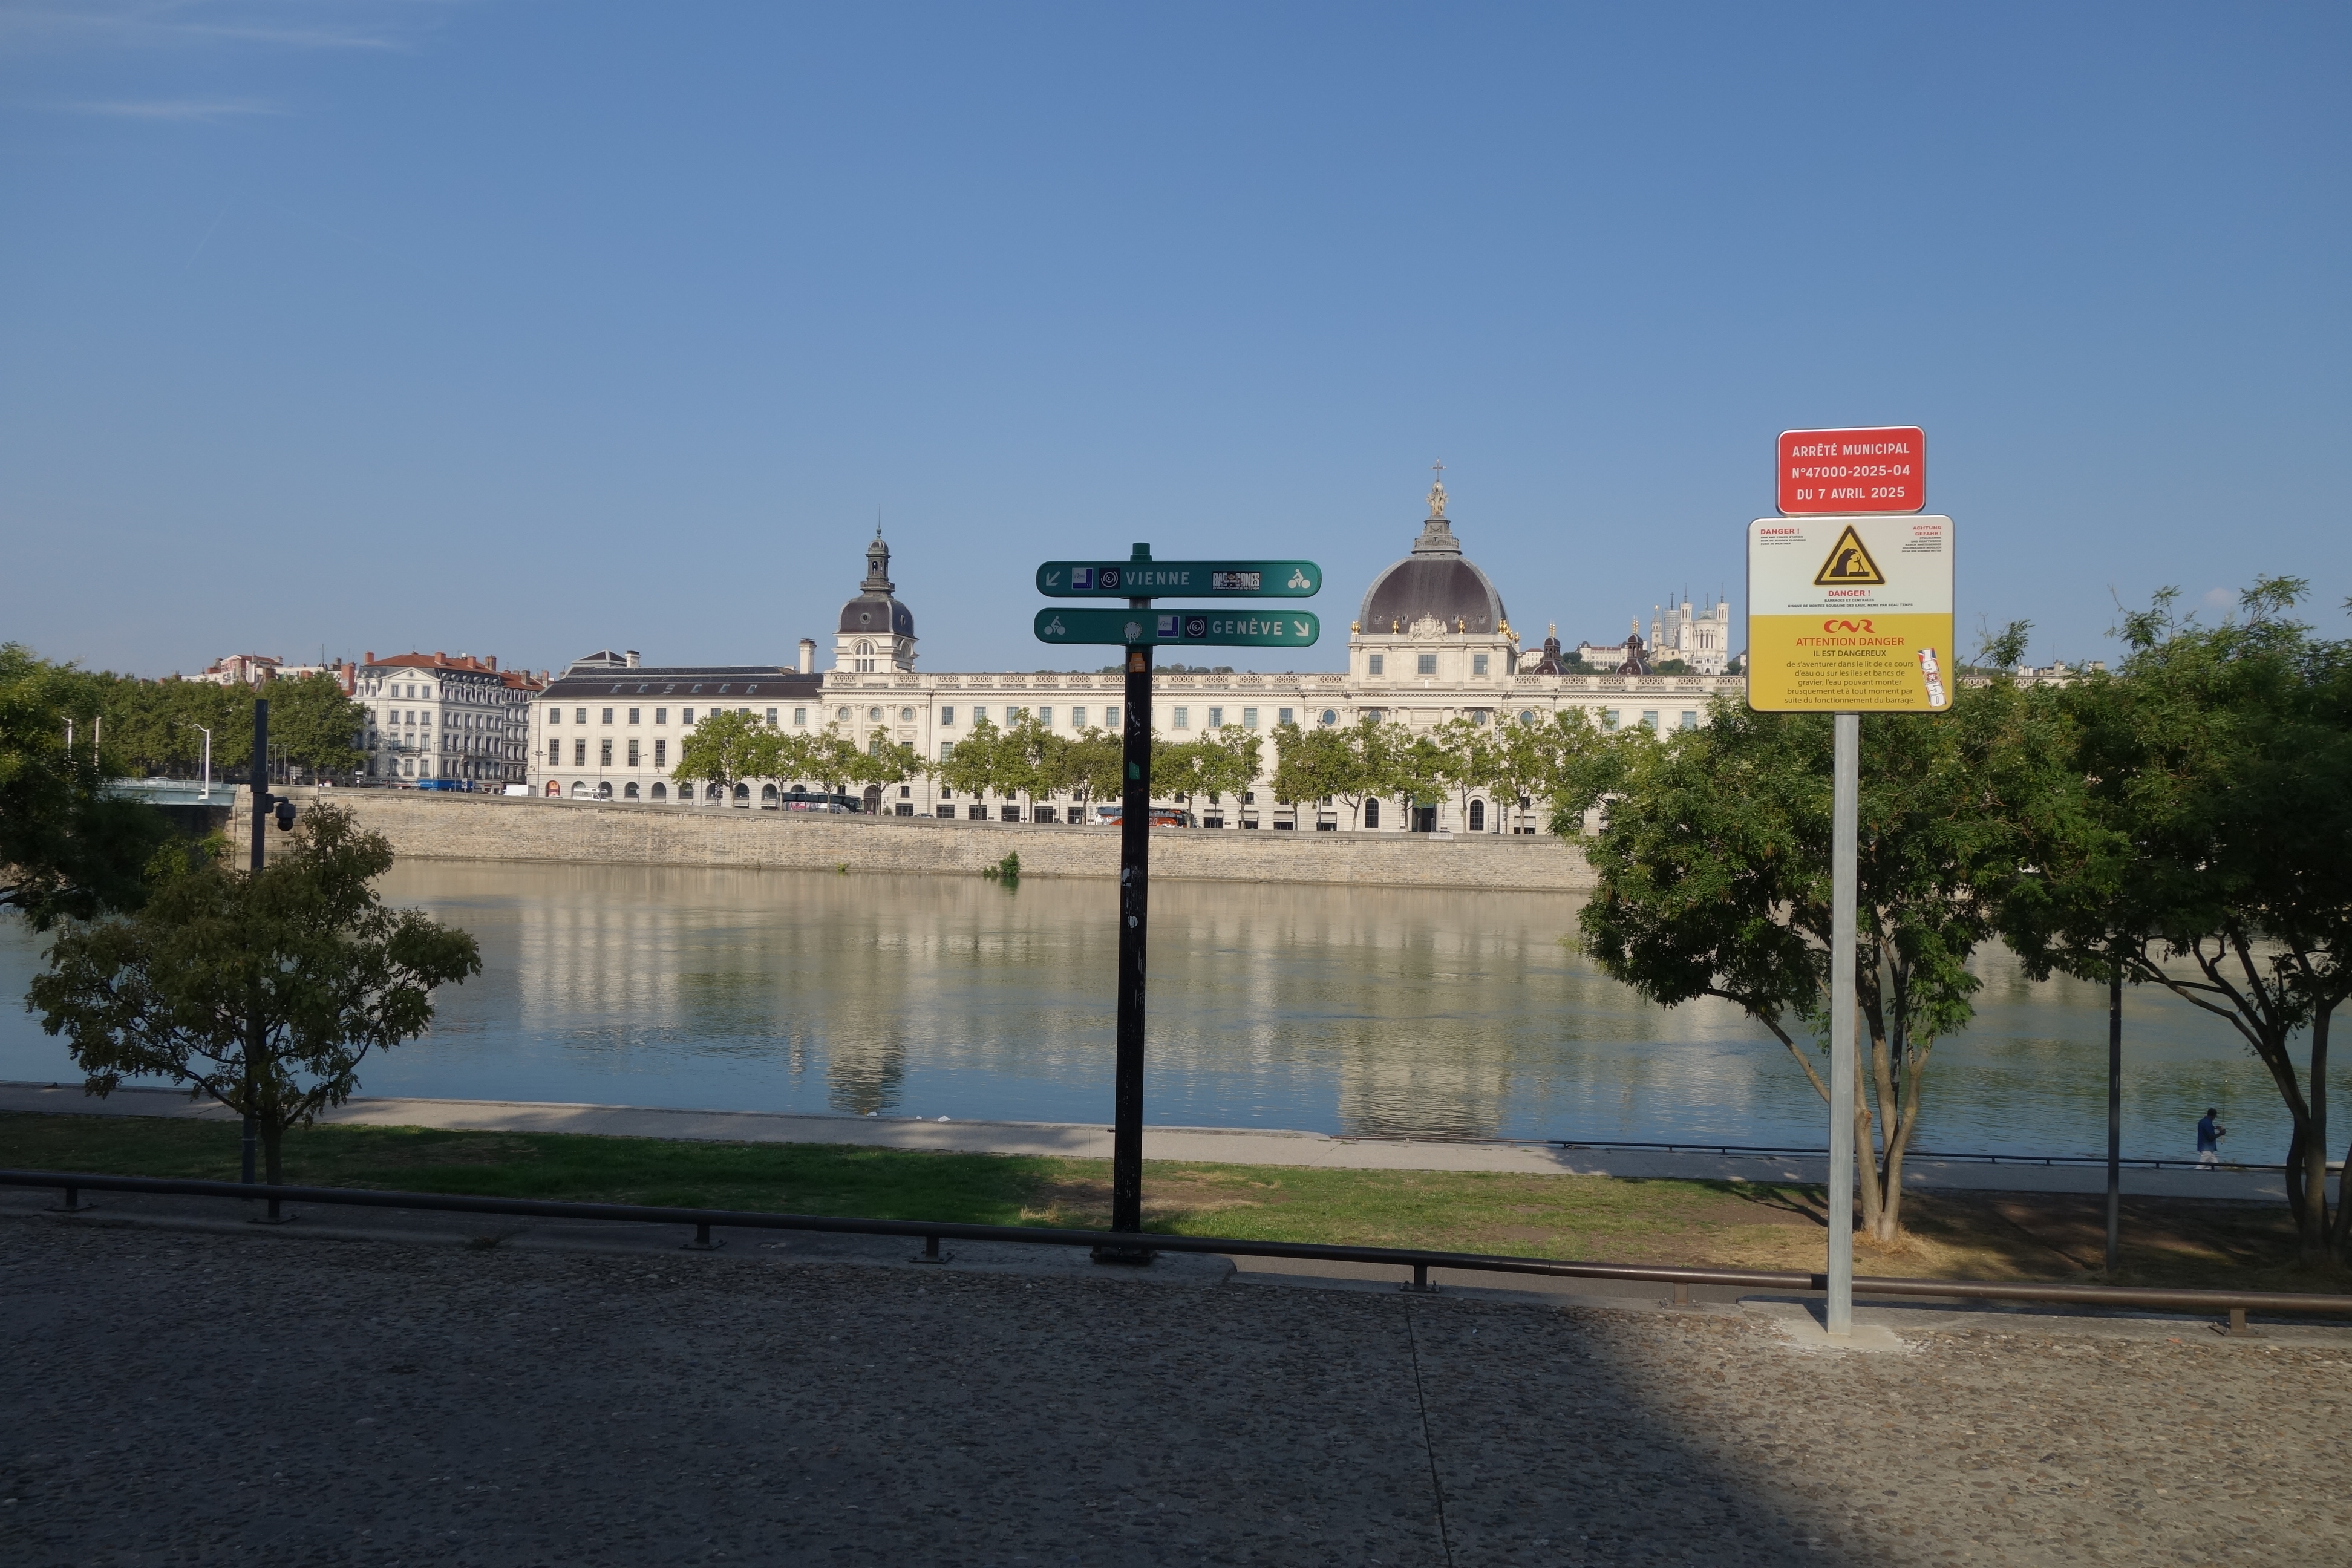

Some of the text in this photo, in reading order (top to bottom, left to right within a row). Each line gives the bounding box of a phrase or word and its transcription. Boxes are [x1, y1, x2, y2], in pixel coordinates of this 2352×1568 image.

[1792, 443, 1910, 457] ARRÊTÉ MUNICIPAL
[1792, 465, 1910, 478] N°47000-2025-04
[1797, 486, 1905, 500] DU 7 AVRIL 2025
[1126, 572, 1191, 586] VIENNE
[1213, 573, 1259, 587] BAD GONES
[1212, 618, 1282, 635] GENÈVE
[1796, 637, 1904, 647] ATTENTION DANGER
[1886, 696, 1915, 705] barrage.
